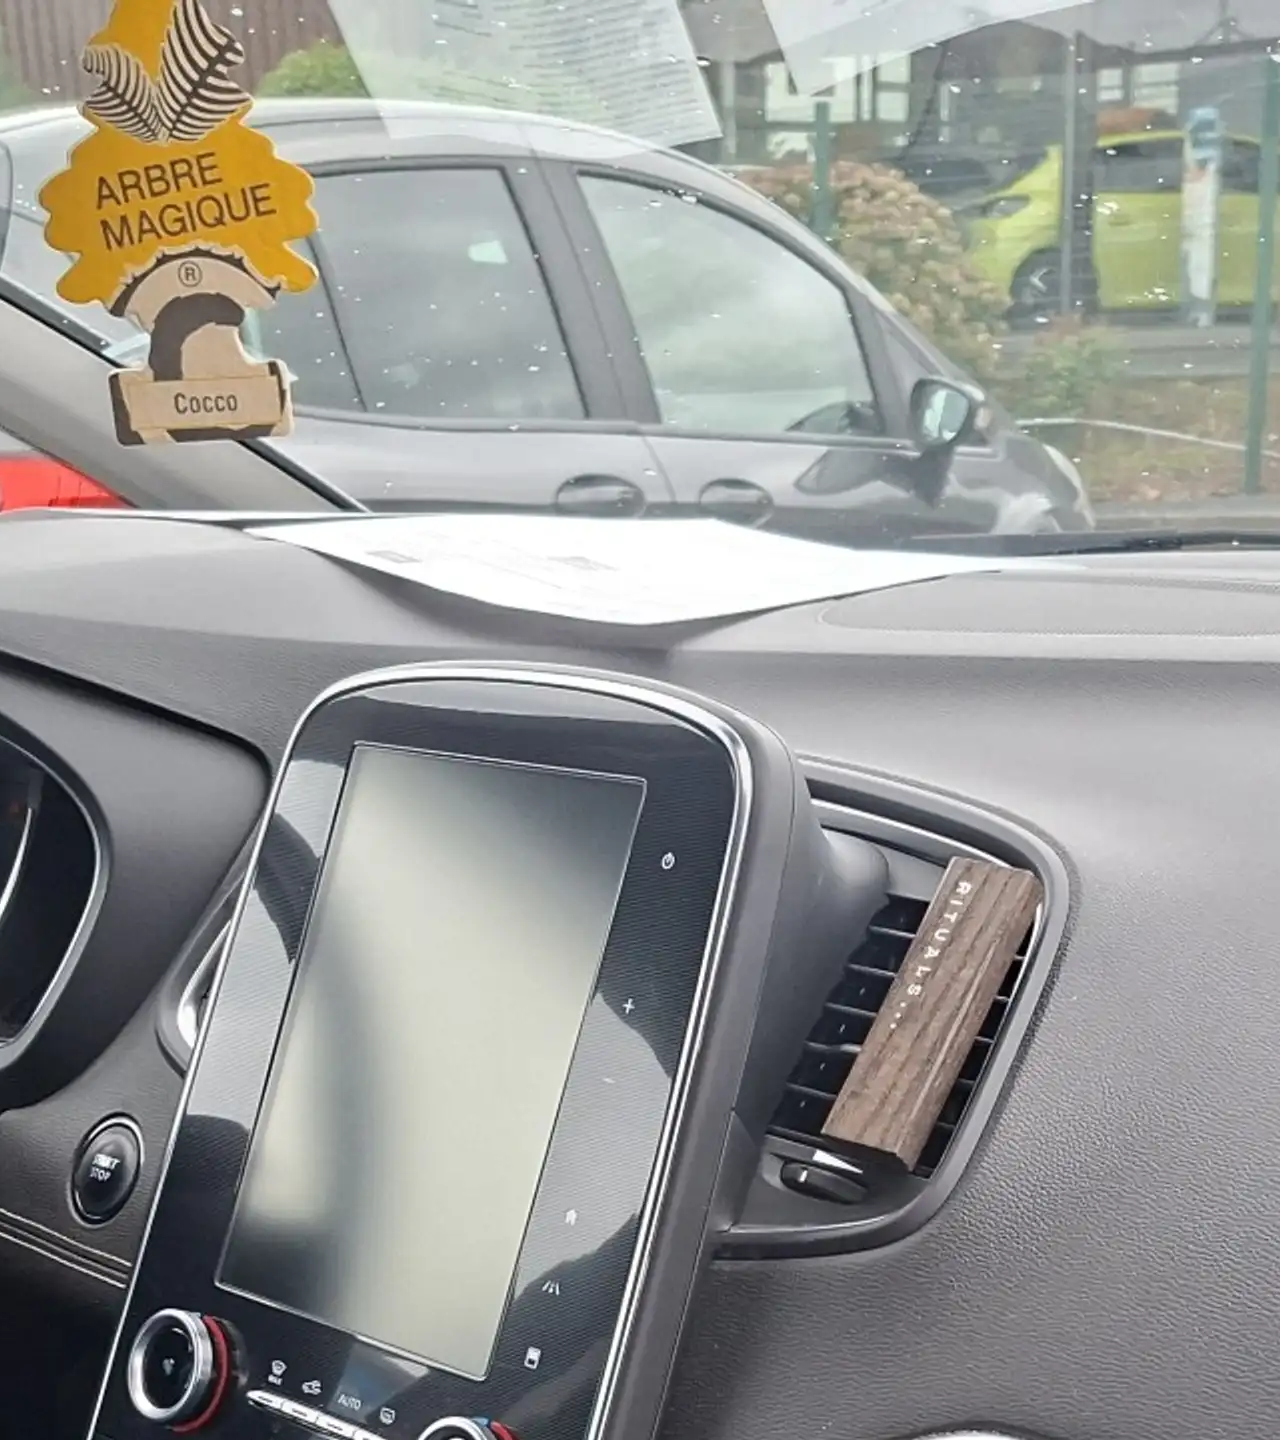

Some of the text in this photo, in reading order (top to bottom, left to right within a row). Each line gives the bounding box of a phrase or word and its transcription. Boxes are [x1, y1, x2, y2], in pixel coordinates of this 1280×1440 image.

[96, 152, 222, 210] ARBRE
[100, 183, 277, 251] MAGIQUE
[90, 1166, 112, 1181] STOP
[337, 1394, 362, 1411] AUTO
